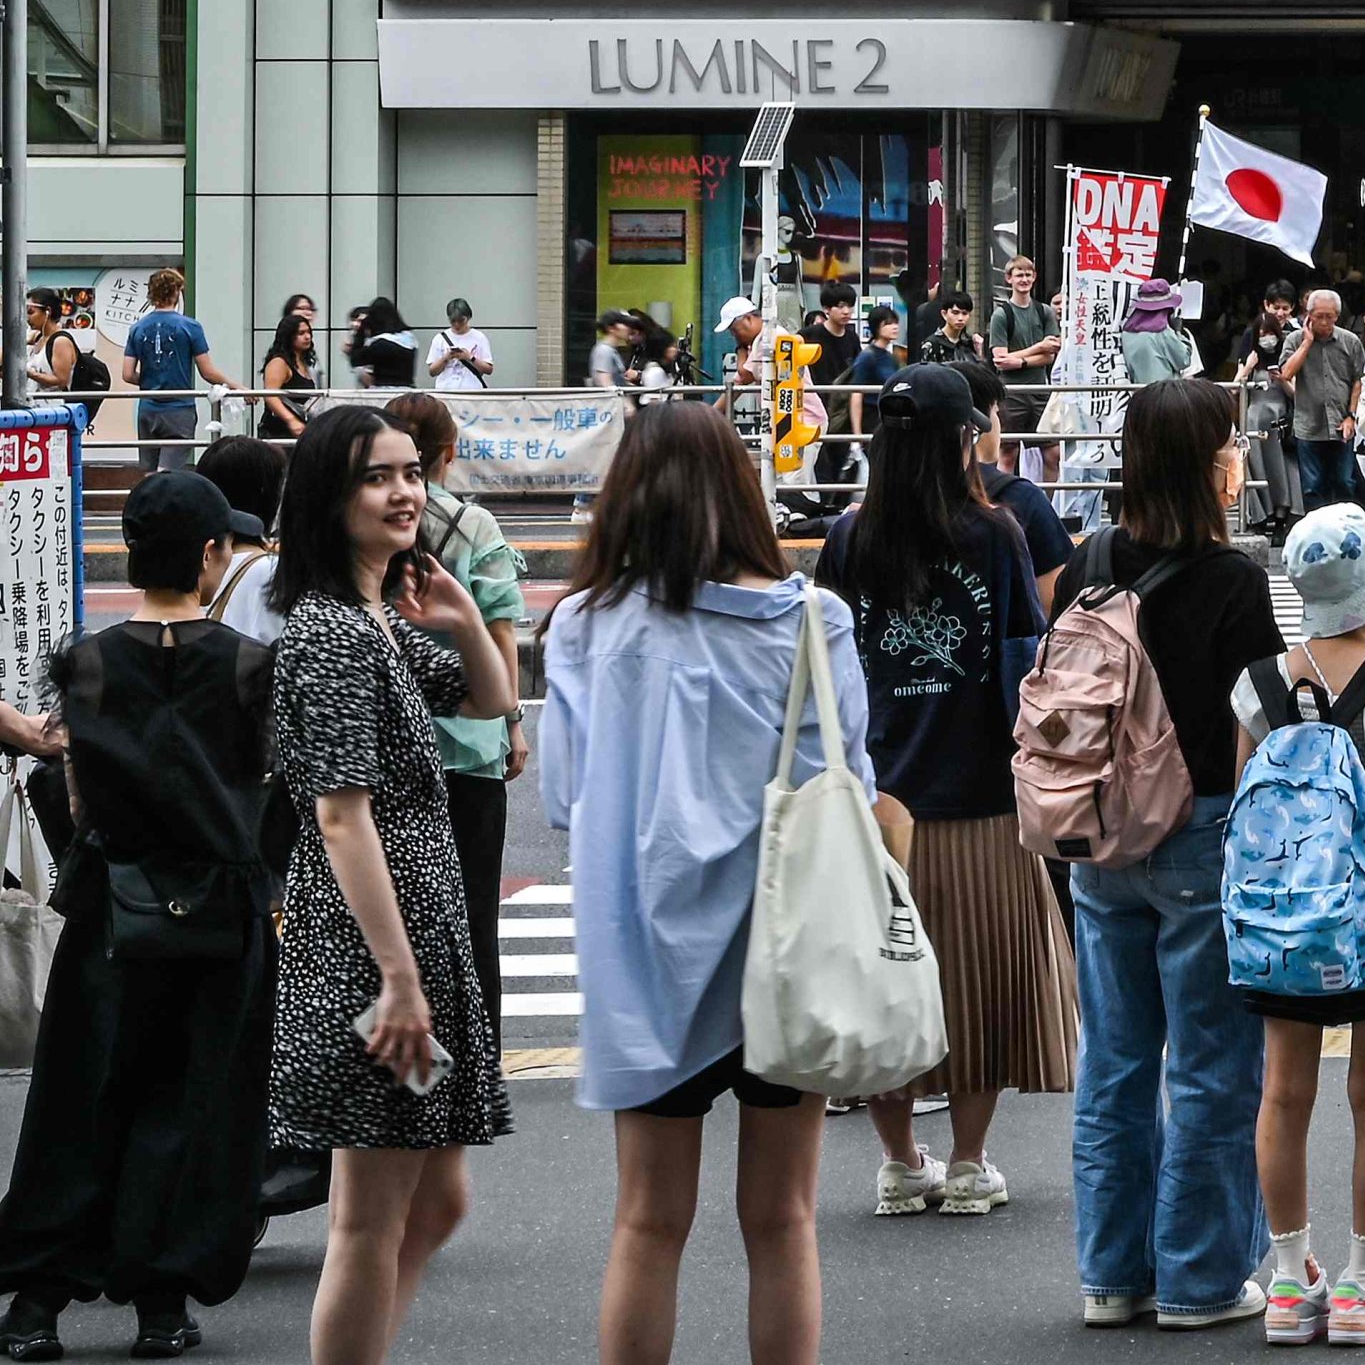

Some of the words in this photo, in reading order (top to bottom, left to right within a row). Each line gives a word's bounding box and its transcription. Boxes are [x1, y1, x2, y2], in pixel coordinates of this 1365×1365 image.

[588, 38, 835, 94] LUMINE
[853, 38, 889, 94] 2
[609, 178, 719, 200] JOURNEY
[610, 154, 732, 176] IMAGINARY
[1076, 178, 1160, 232] DNA
[1075, 225, 1159, 277] 鑑定
